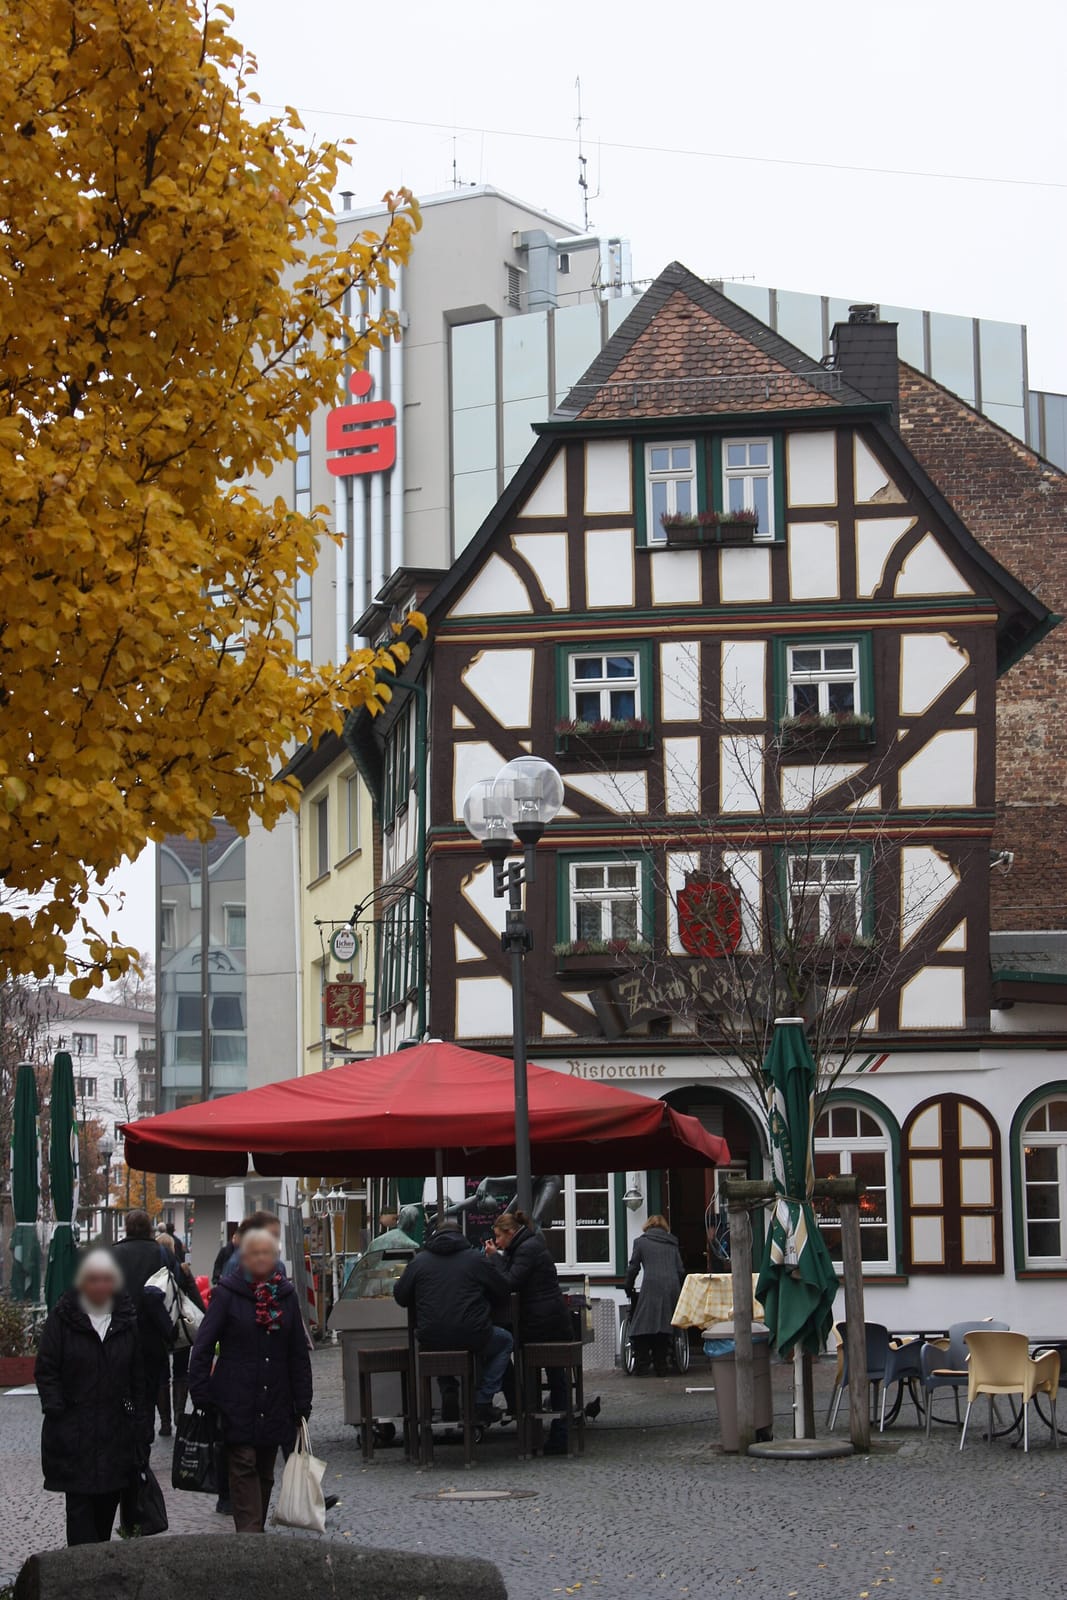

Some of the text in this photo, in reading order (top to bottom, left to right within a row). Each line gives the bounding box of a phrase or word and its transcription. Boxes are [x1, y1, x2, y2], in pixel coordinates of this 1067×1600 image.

[336, 939, 354, 948] Licher
[618, 978, 688, 1020] Zum
[566, 1060, 667, 1078] Ristorante
